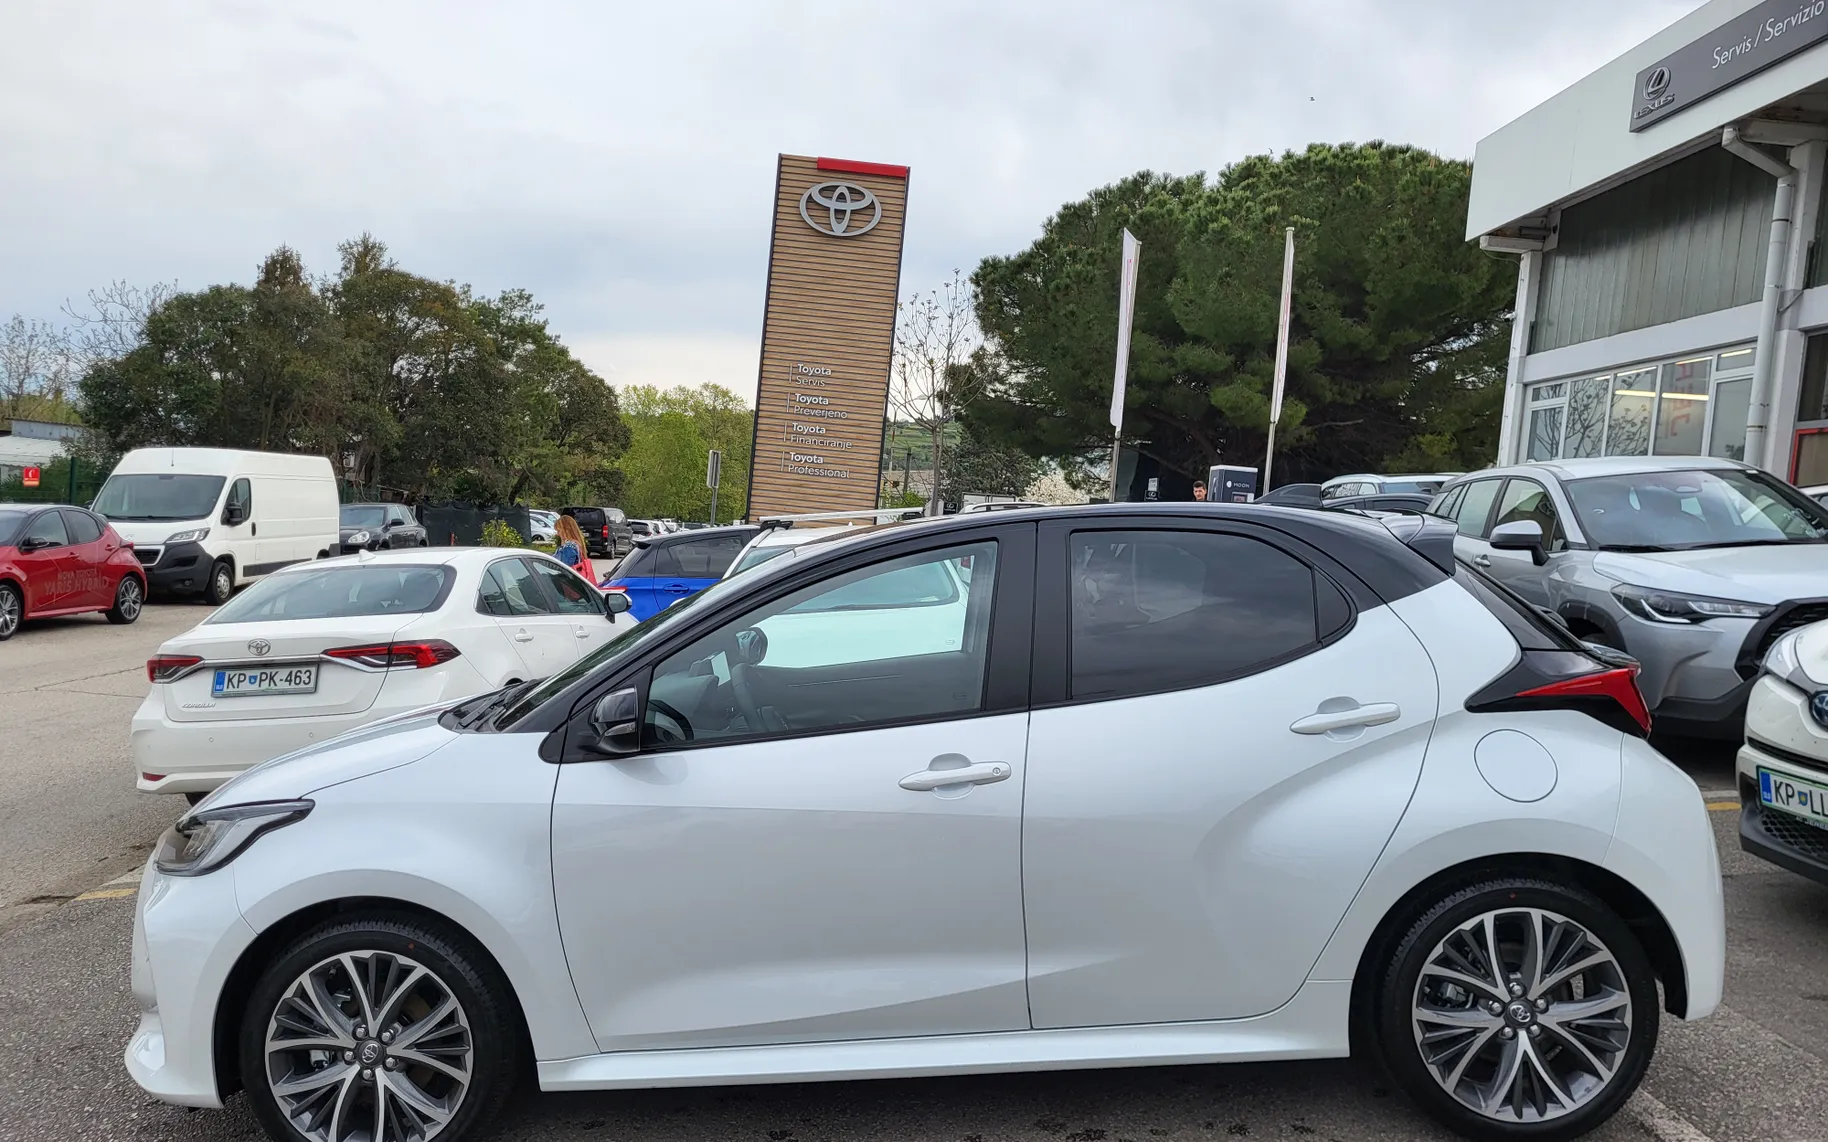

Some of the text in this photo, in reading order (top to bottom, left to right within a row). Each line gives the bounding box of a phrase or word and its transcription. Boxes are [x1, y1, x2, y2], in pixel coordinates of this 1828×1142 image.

[1712, 35, 1751, 69] Servis
[1764, 0, 1825, 41] Servizio
[1633, 93, 1674, 119] LEXUS
[797, 364, 831, 375] Toyota
[795, 376, 825, 387] Servis
[794, 393, 829, 405] Toyota
[793, 406, 848, 419] Preverjeno
[792, 423, 826, 434] Toyota
[790, 435, 852, 449] Financiranje
[789, 452, 824, 464] Toyota
[788, 465, 850, 478] Professional
[226, 669, 312, 690] KP PK-463
[1773, 779, 1795, 806] KP
